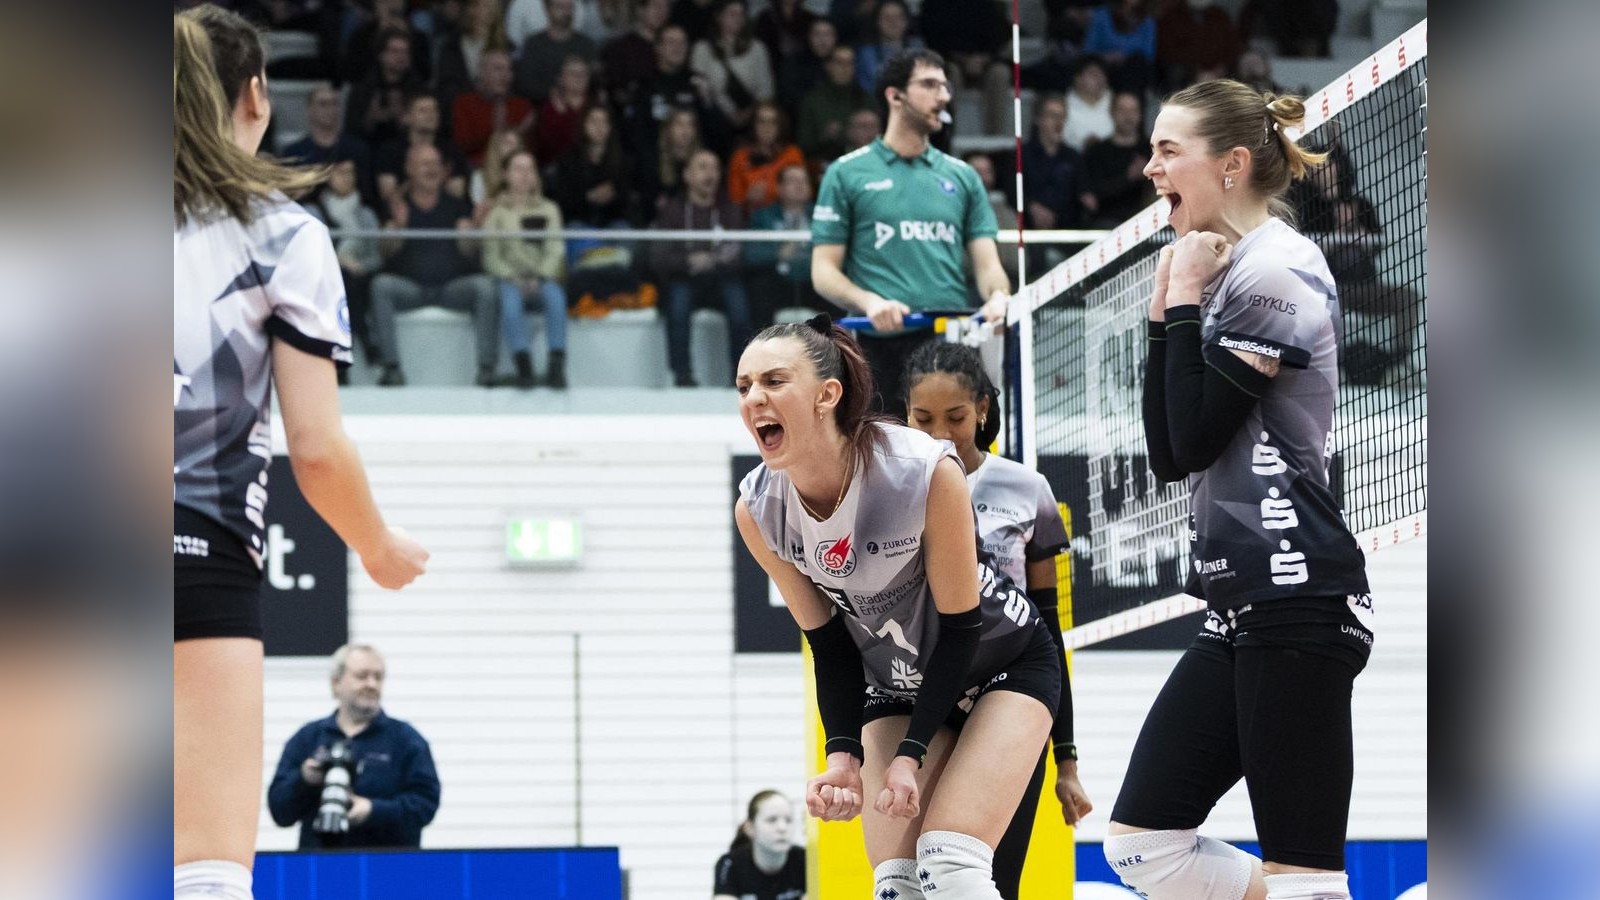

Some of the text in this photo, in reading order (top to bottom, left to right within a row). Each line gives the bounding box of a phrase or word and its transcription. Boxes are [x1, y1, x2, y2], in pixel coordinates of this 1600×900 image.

[1248, 294, 1298, 316] IBYKUS
[1218, 336, 1281, 359] Samt&Seidel
[991, 506, 1019, 517] ZURICH
[882, 536, 917, 550] ZURICH
[825, 559, 853, 576] ERFURT
[859, 601, 895, 616] Erfurt
